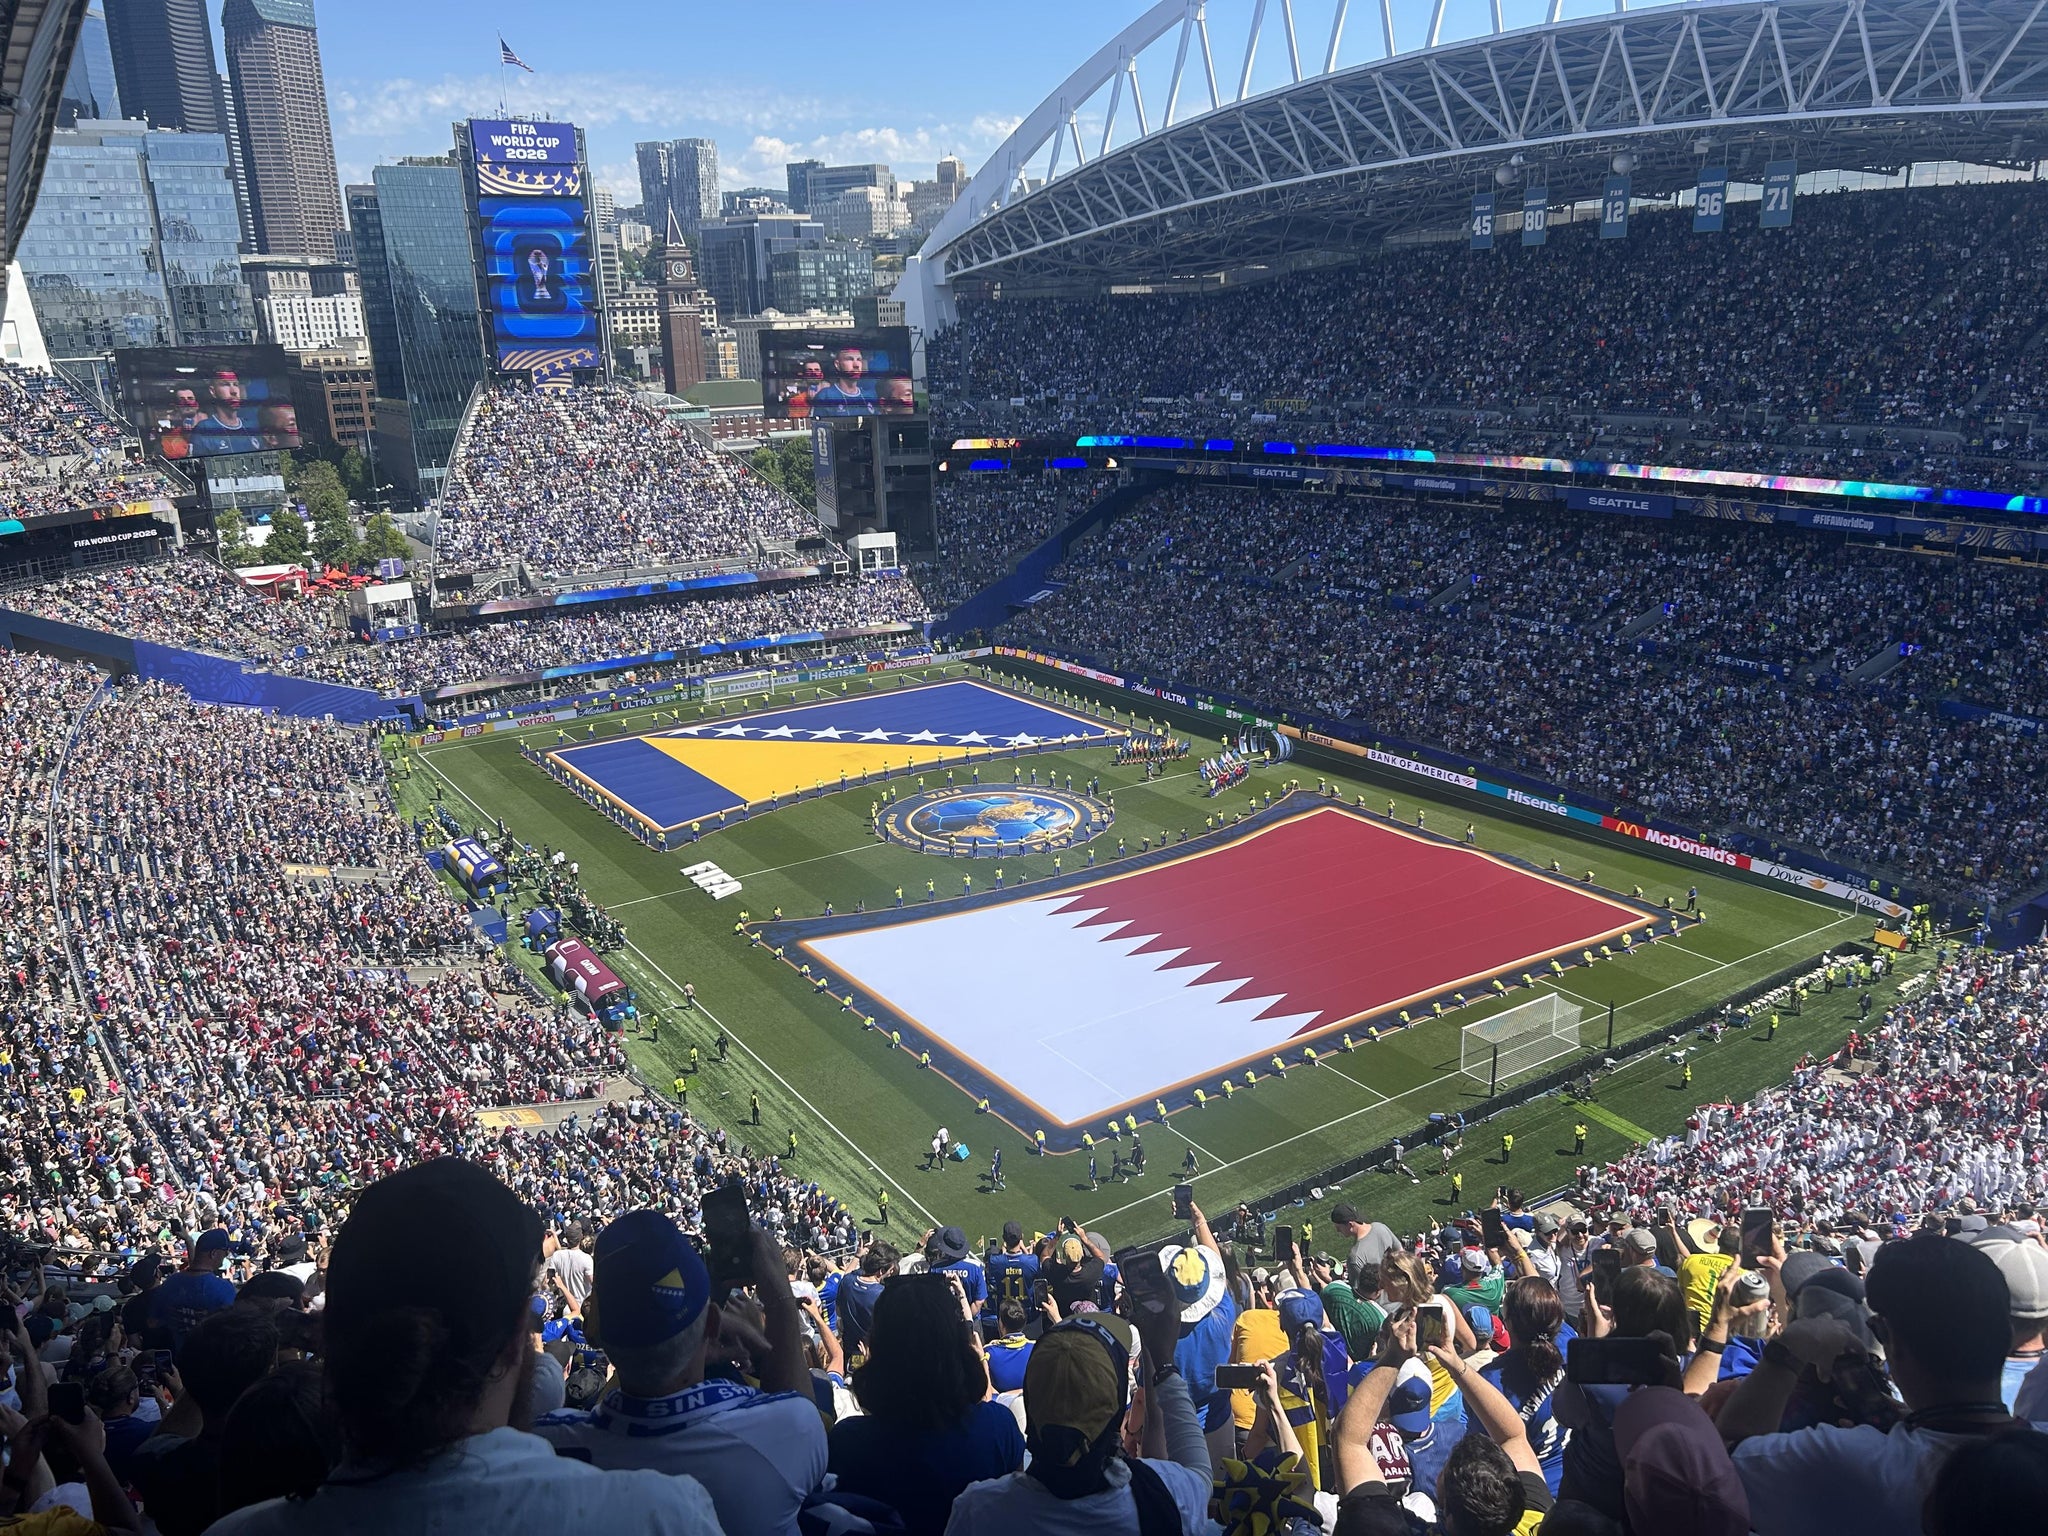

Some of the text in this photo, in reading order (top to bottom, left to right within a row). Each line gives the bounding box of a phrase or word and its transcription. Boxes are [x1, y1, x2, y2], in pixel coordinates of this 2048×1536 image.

[511, 124, 537, 135] FIFA
[491, 135, 560, 148] WORLD CUP
[505, 149, 548, 160] 2026
[1697, 192, 1722, 216] 96
[1766, 186, 1788, 211] 71
[1604, 200, 1625, 224] 12
[1472, 215, 1492, 235] 45
[1525, 210, 1544, 231] 80
[1252, 468, 1298, 478] SEATTLE
[1588, 496, 1649, 511] SEATTLE
[1812, 514, 1874, 531] #FIFAWorldCup
[74, 529, 157, 548] FIFA WORLD CUP 2026
[884, 656, 930, 669] McDonald's
[809, 667, 857, 680] Hisense
[1066, 665, 1087, 677] verizon
[1095, 673, 1117, 685] verizon
[730, 683, 749, 691] BANK
[760, 678, 790, 686] AMRICA
[621, 698, 653, 709] ULTRA
[1162, 689, 1187, 706] ULTRA
[485, 711, 501, 720] FIFA
[517, 715, 555, 727] verizon
[1308, 733, 1333, 747] SEATTLE
[1370, 750, 1461, 784] BANK OF AMERICA
[1506, 788, 1568, 816] Hisense
[1645, 828, 1737, 867] McDonald's
[1766, 865, 1803, 885] Dove
[1845, 888, 1881, 909] Dove
[1002, 1276, 1026, 1300] 11
[647, 1392, 706, 1417] SIN
[1384, 1466, 1412, 1476] ARAJE
